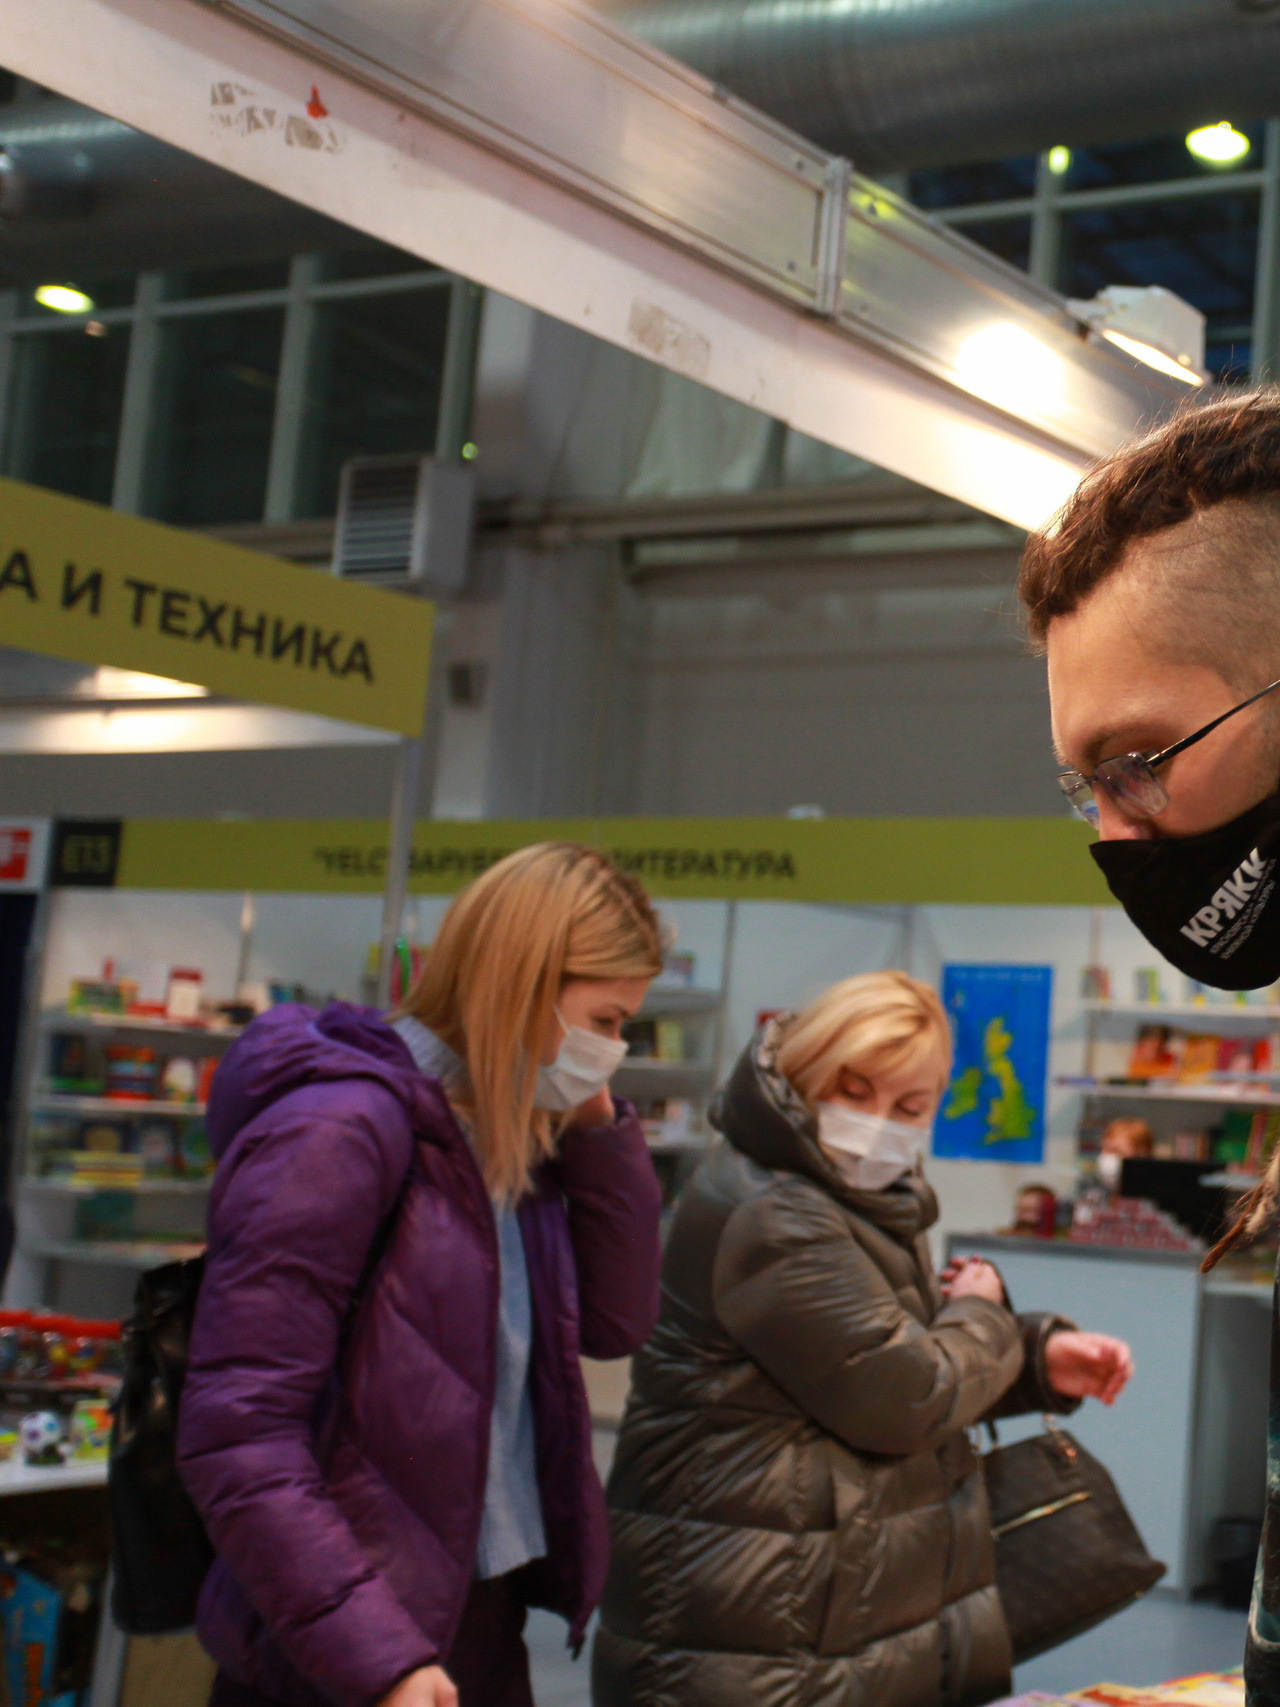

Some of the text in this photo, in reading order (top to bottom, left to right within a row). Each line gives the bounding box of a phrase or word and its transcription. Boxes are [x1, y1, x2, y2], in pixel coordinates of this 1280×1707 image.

[60, 563, 104, 616] И
[124, 577, 375, 684] ТЕХНИКА
[611, 847, 797, 881] ИТЕРАТУРА
[1179, 847, 1267, 948] КРЯКК
